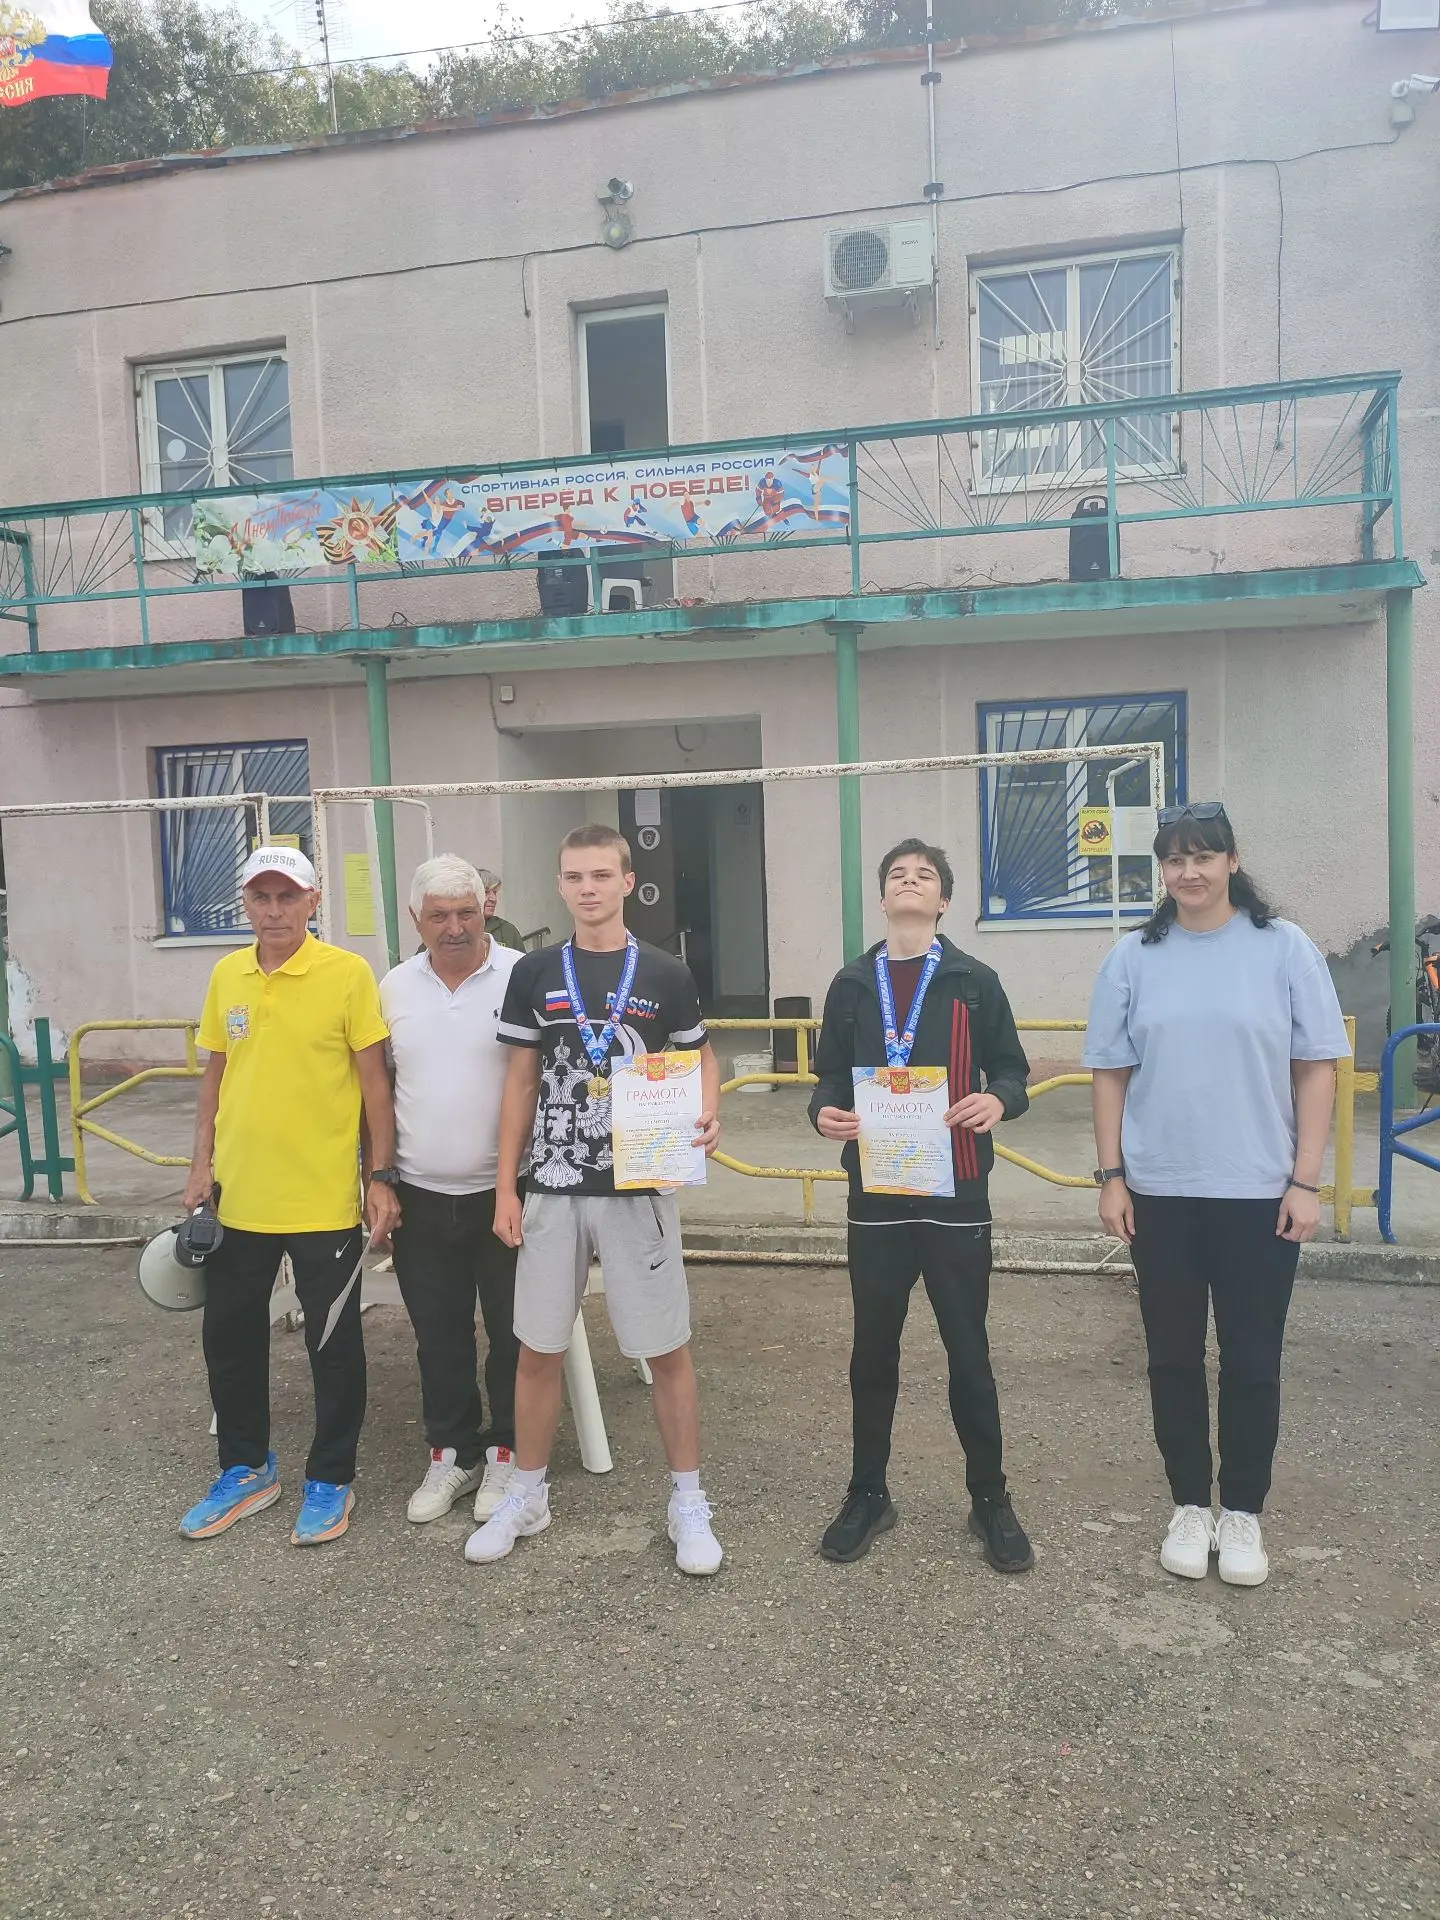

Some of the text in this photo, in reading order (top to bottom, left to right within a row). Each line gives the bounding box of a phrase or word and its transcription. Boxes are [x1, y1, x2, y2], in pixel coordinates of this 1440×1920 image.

[461, 457, 775, 495] СПОРТИВНАЯ РОССИЯ, СИЛЬНАЯ РОССИЯ
[603, 486, 620, 503] К
[630, 474, 750, 501] ПОБЕДЕ!
[258, 854, 297, 868] RUSSIA
[605, 991, 660, 1020] RSSIA
[626, 1086, 688, 1102] ГРАМОТА
[869, 1101, 934, 1114] ГРАМОТА
